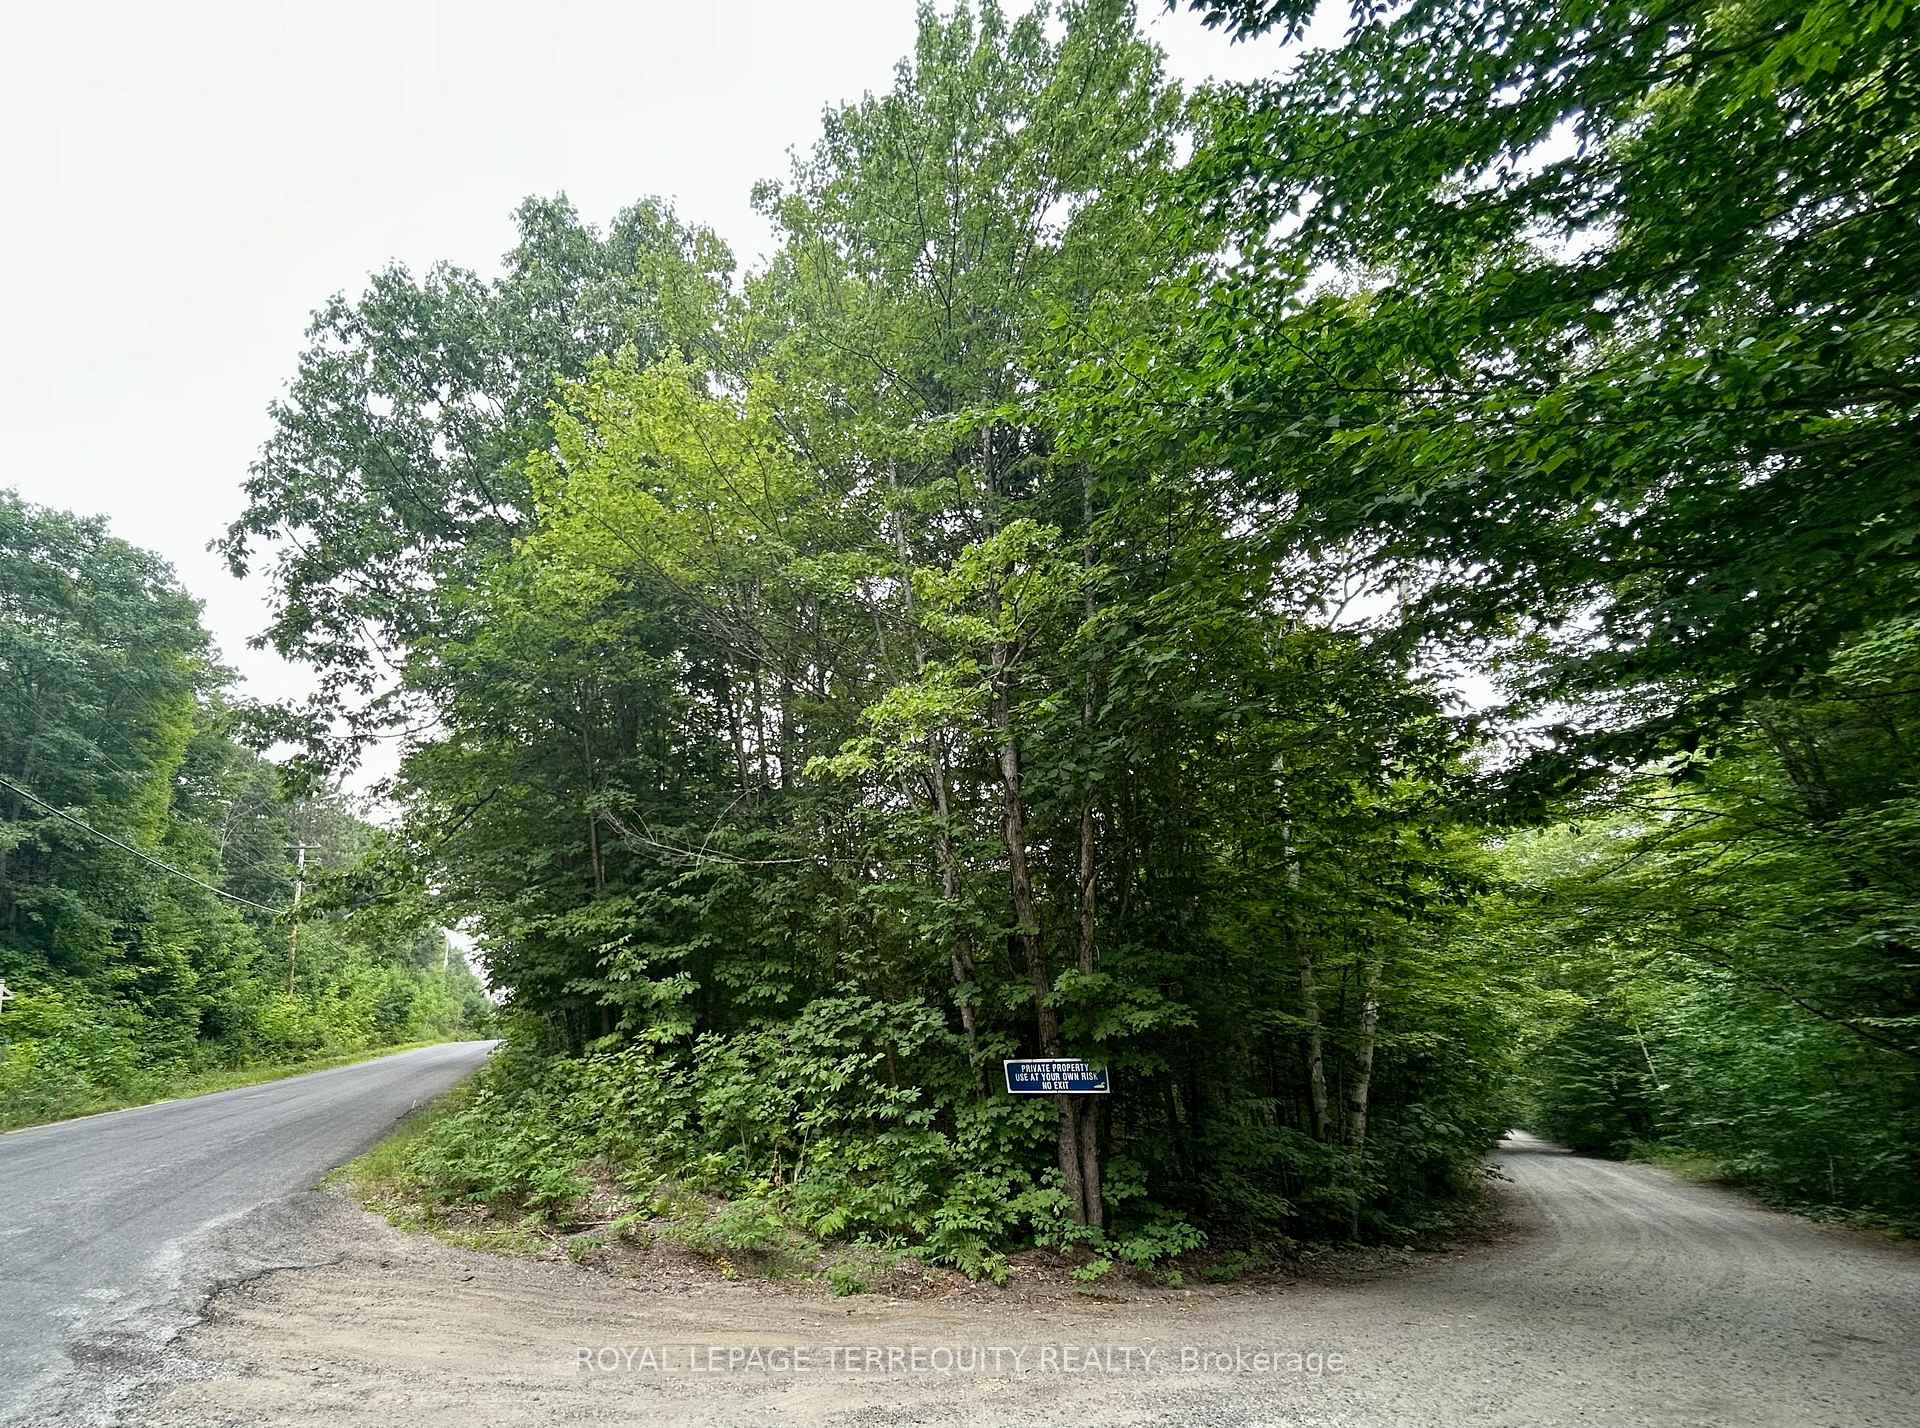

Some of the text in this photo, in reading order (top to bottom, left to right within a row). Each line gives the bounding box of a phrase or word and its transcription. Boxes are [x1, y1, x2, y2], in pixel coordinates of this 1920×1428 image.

[1021, 1063, 1089, 1073] PRIVATE PROPERTY
[1015, 1071, 1098, 1082] USE AT YOUR OWN RISK
[1042, 1081, 1069, 1090] NO EXIT
